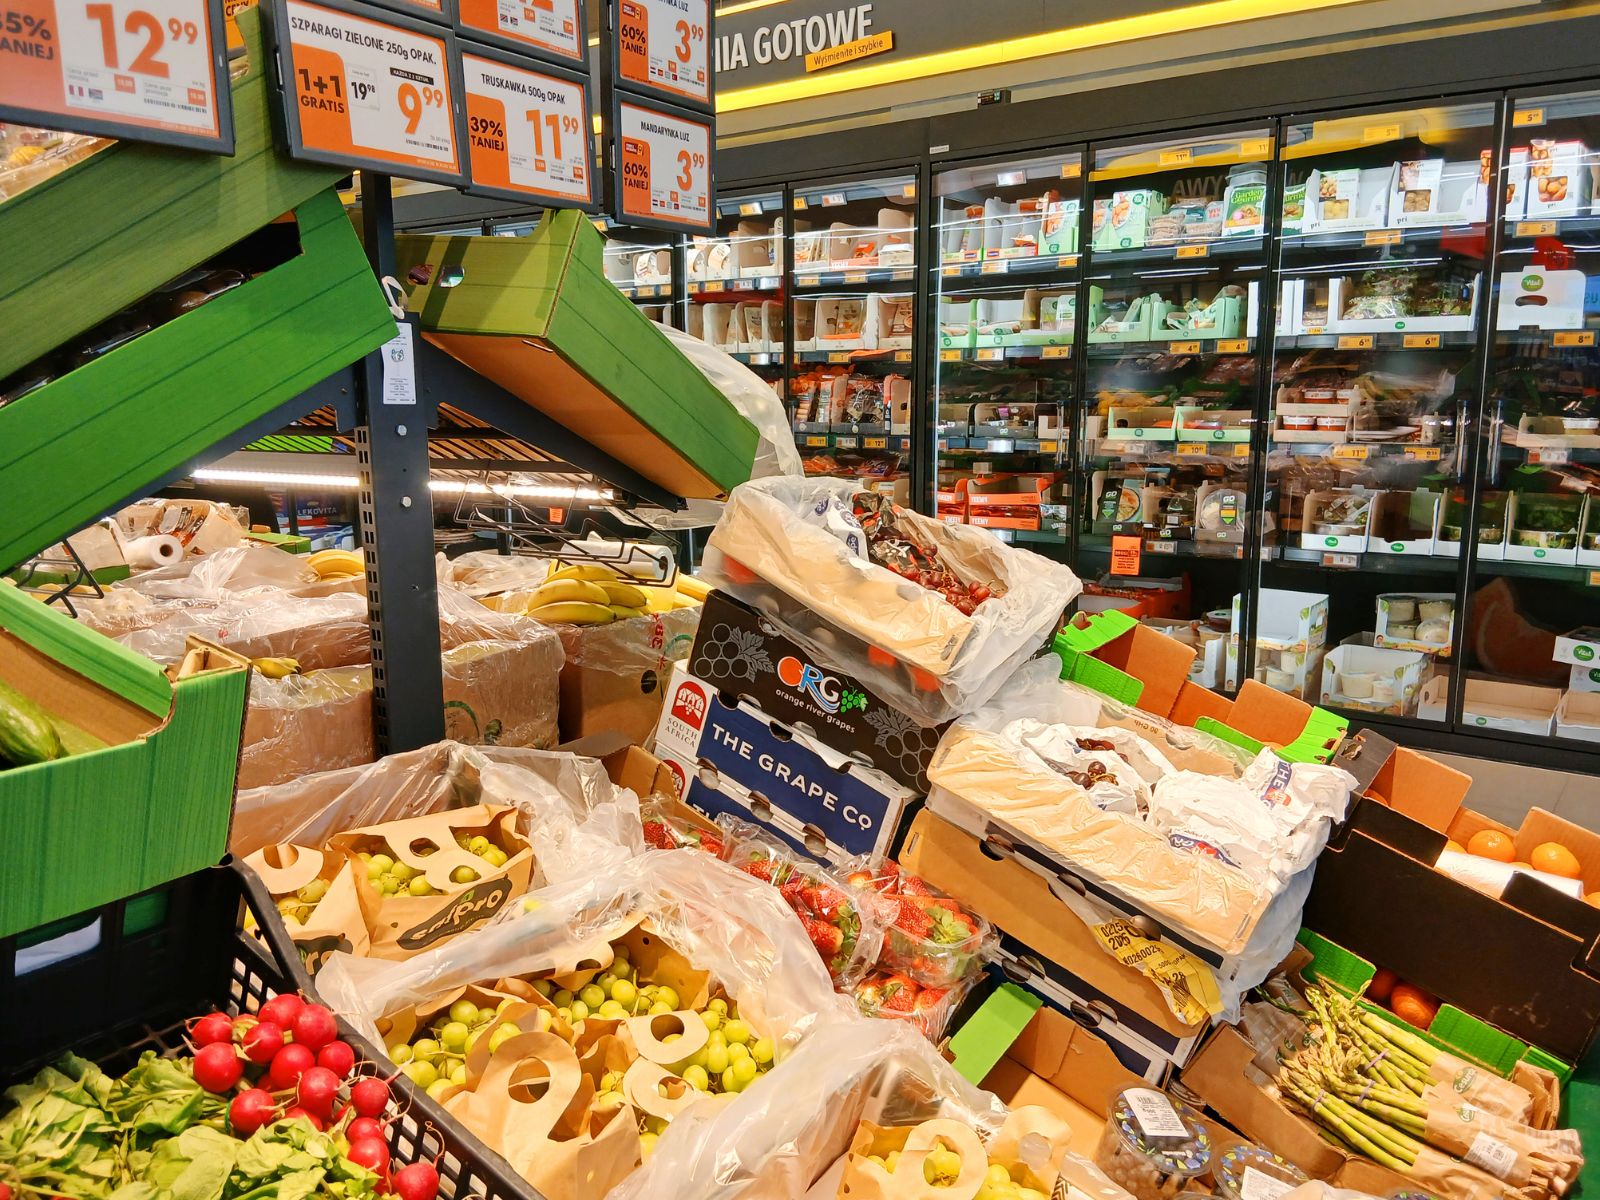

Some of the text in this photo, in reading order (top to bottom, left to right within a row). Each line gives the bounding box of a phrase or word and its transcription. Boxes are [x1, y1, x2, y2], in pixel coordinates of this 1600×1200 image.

[0, 11, 52, 41] 5%
[621, 24, 646, 44] 60%
[753, 4, 873, 64] GOTOWE
[0, 36, 54, 60] ANIEJ
[291, 17, 342, 40] SZPARAGI
[345, 30, 384, 51] ZIELONE
[387, 42, 409, 60] 250g
[621, 40, 646, 56] TANIEJ
[857, 38, 884, 54] szybkie
[299, 68, 341, 98] 1+1
[481, 73, 565, 104] TRUSKAWKA 500g OPAK
[300, 95, 345, 113] GRATIS
[470, 116, 503, 138] 39%
[640, 121, 690, 142] MANDARYNKA LUZ
[470, 135, 504, 151] TANIEJ
[624, 162, 648, 179] 60%
[624, 177, 648, 191] TANIEJ
[1222, 495, 1235, 503] GO
[297, 507, 337, 516] LEKOVITA
[775, 688, 856, 734] orange river grapes
[664, 725, 696, 748] AFRICA
[667, 717, 698, 740] SOUTH
[712, 723, 754, 762] THE
[757, 753, 839, 812] GRAPE
